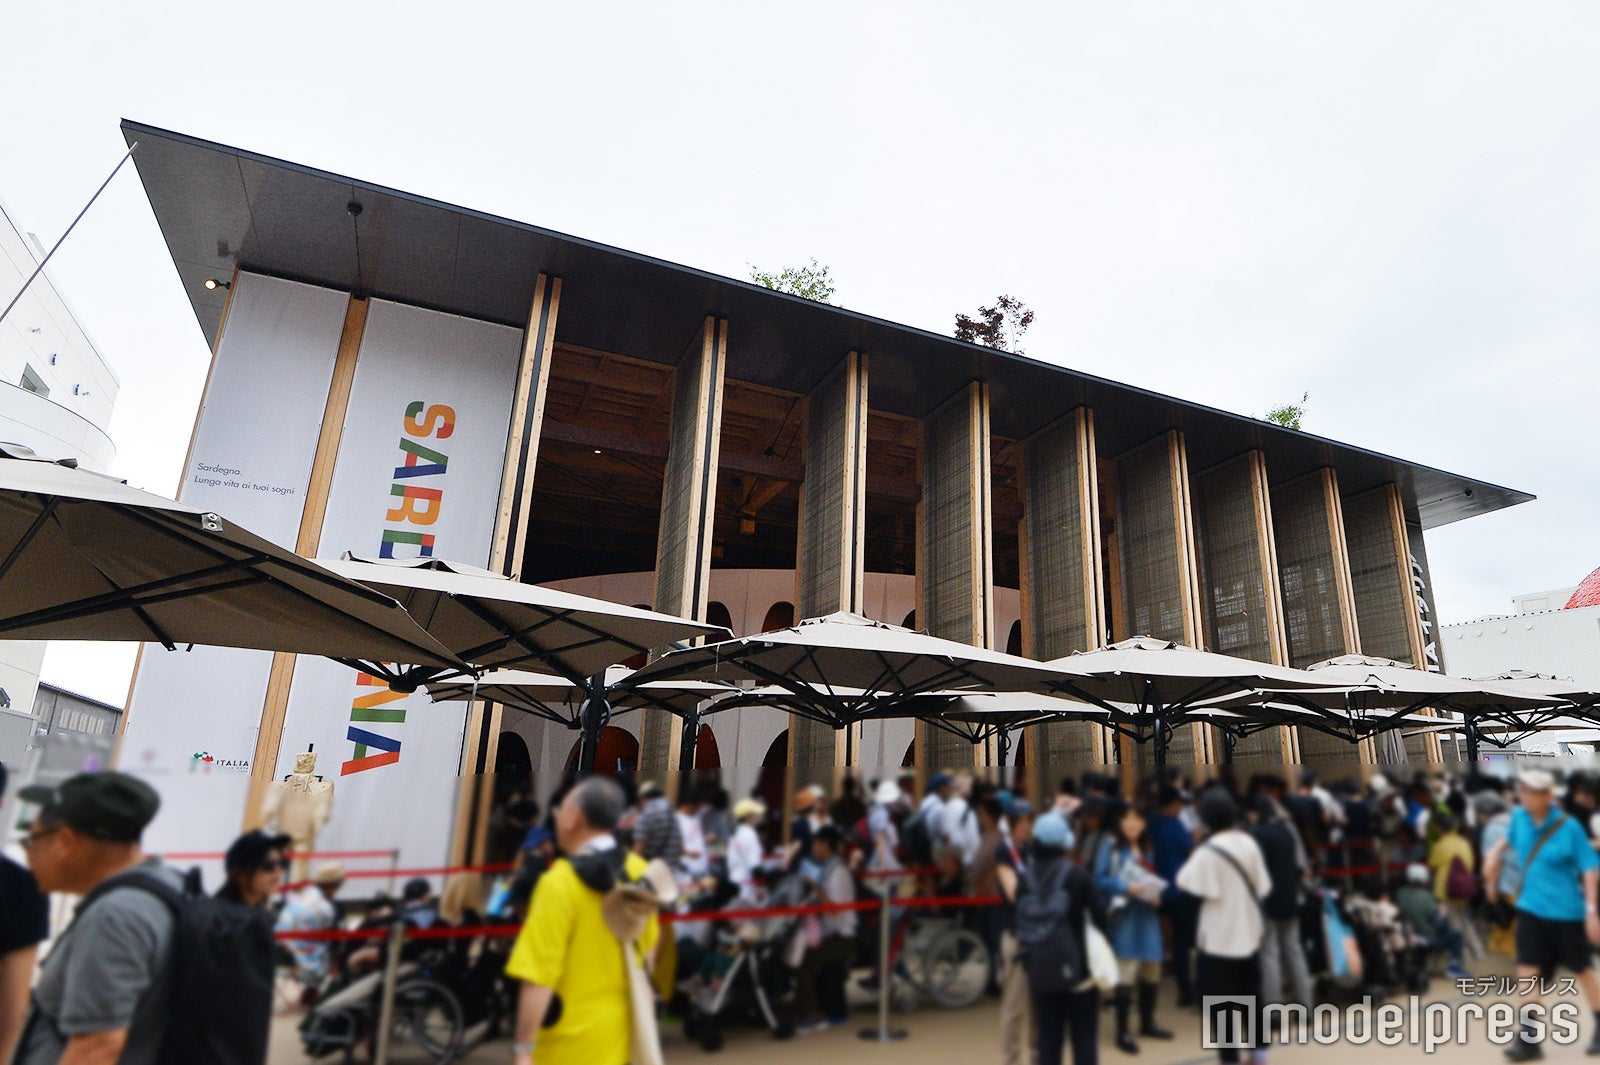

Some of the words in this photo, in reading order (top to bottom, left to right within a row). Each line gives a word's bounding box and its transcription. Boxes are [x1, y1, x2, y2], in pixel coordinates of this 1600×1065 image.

[197, 462, 242, 476] Sardegna.
[194, 475, 221, 487] Lunga
[223, 479, 240, 488] vita
[271, 486, 295, 496] sogni
